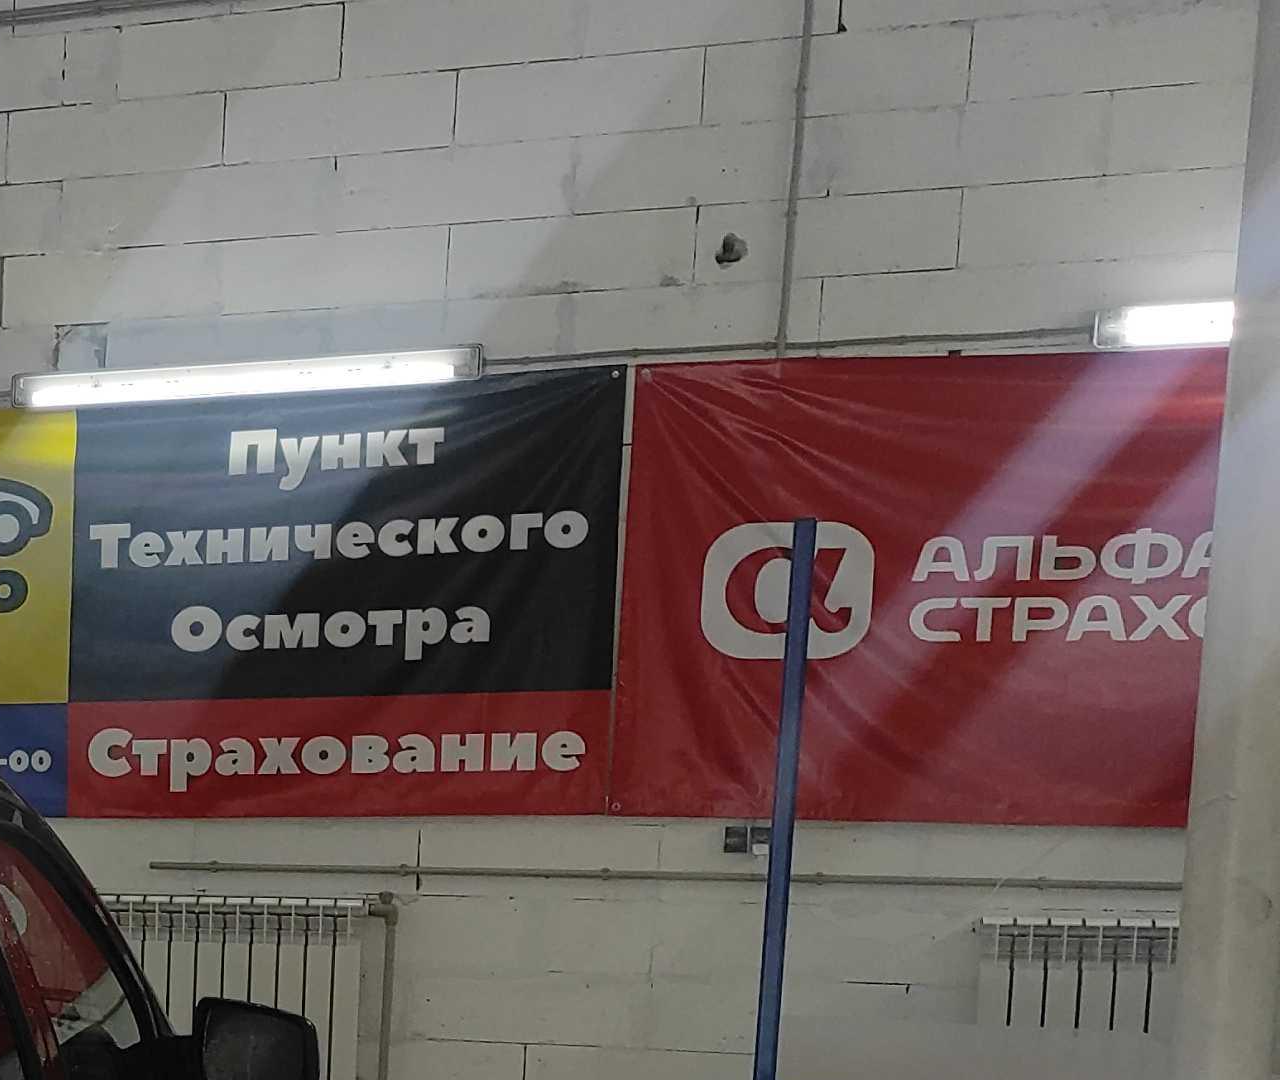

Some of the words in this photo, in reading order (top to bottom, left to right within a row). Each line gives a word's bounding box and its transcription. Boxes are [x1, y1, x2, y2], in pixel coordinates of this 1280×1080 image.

[227, 425, 445, 491] Пункт
[89, 509, 589, 570] Технического
[912, 528, 1214, 584] АЛЬФА
[170, 603, 490, 660] Осмотра
[87, 727, 585, 793] Страхование
